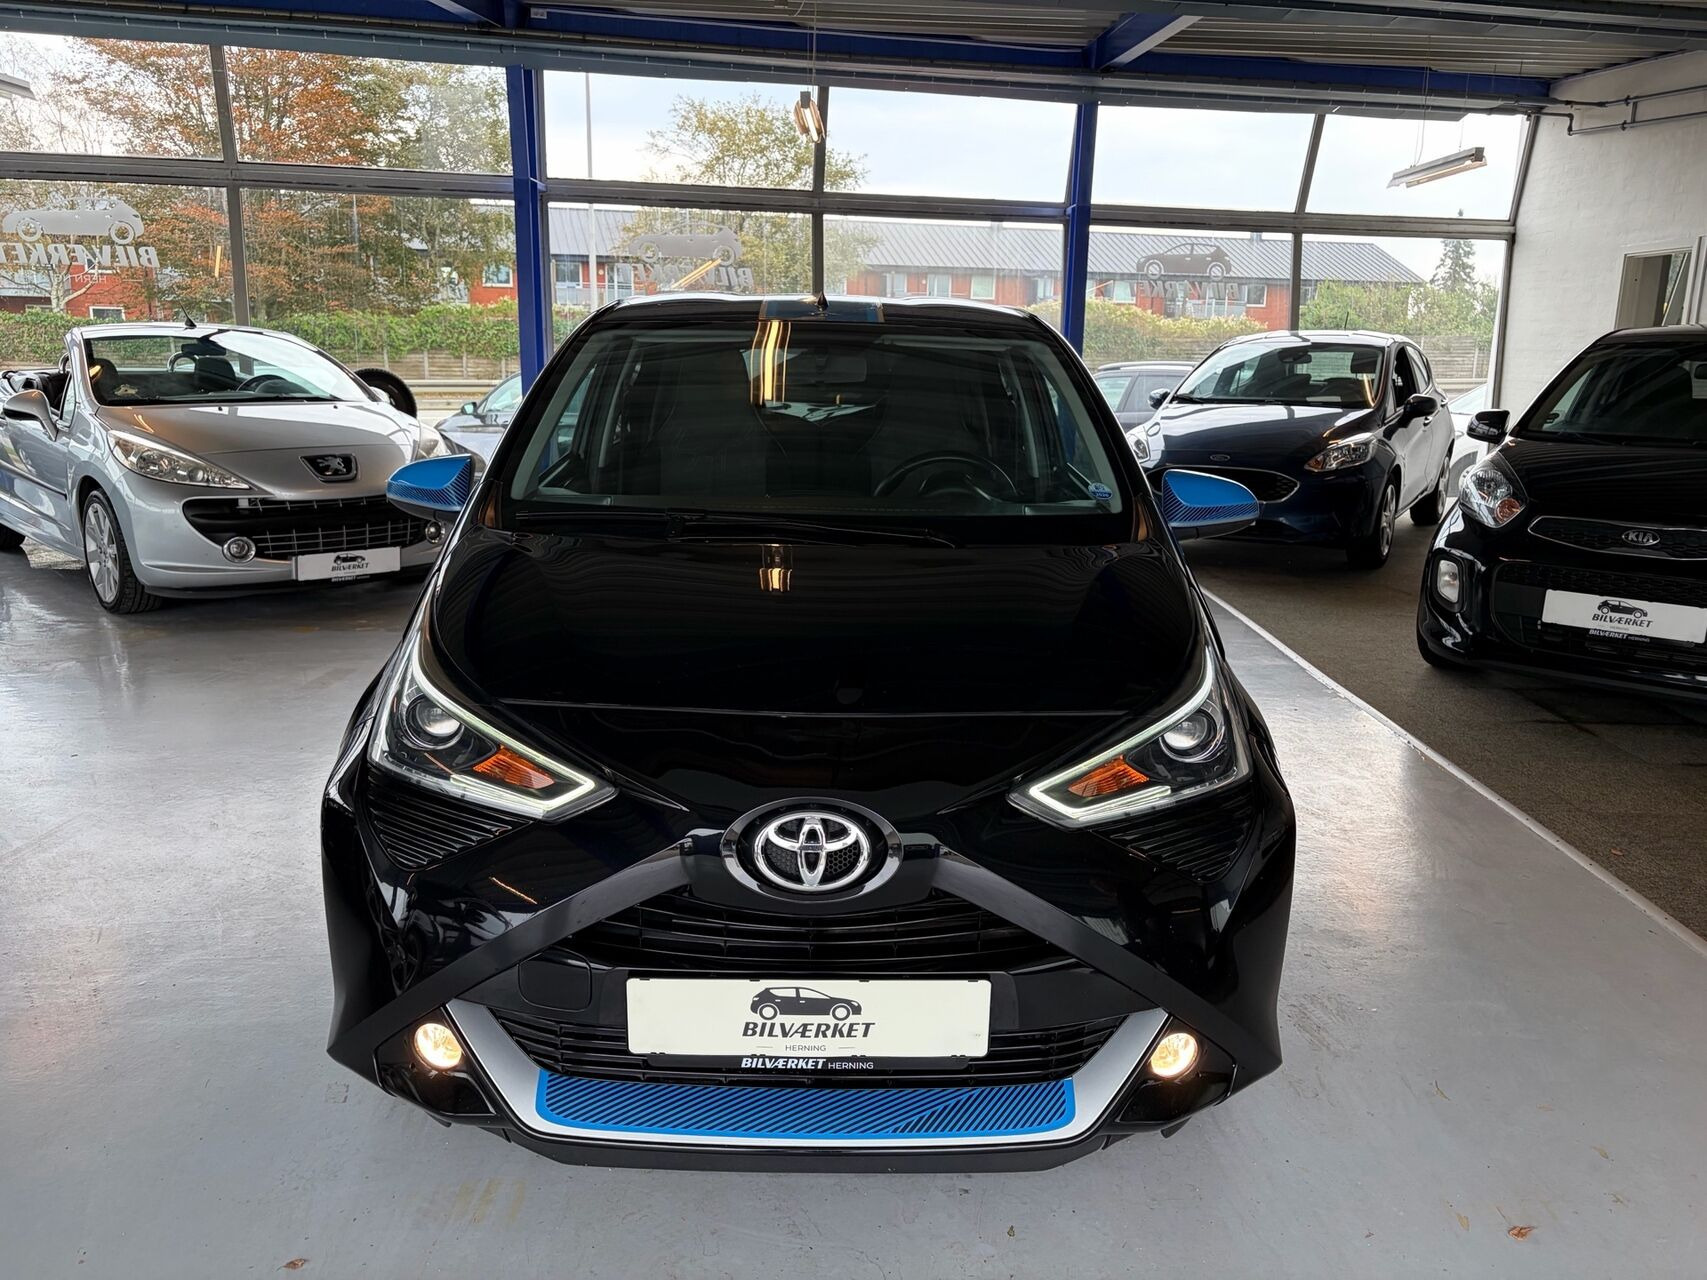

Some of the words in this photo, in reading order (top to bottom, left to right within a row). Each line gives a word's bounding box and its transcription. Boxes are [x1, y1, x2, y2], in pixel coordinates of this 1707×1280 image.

[1628, 531, 1653, 544] KIA
[1592, 613, 1653, 628] BILVÆRKET
[742, 1021, 876, 1039] BILVÆRKET
[785, 1044, 827, 1052] HERNING
[740, 1057, 827, 1070] BILVÆRKET
[828, 1061, 874, 1070] HERNING
